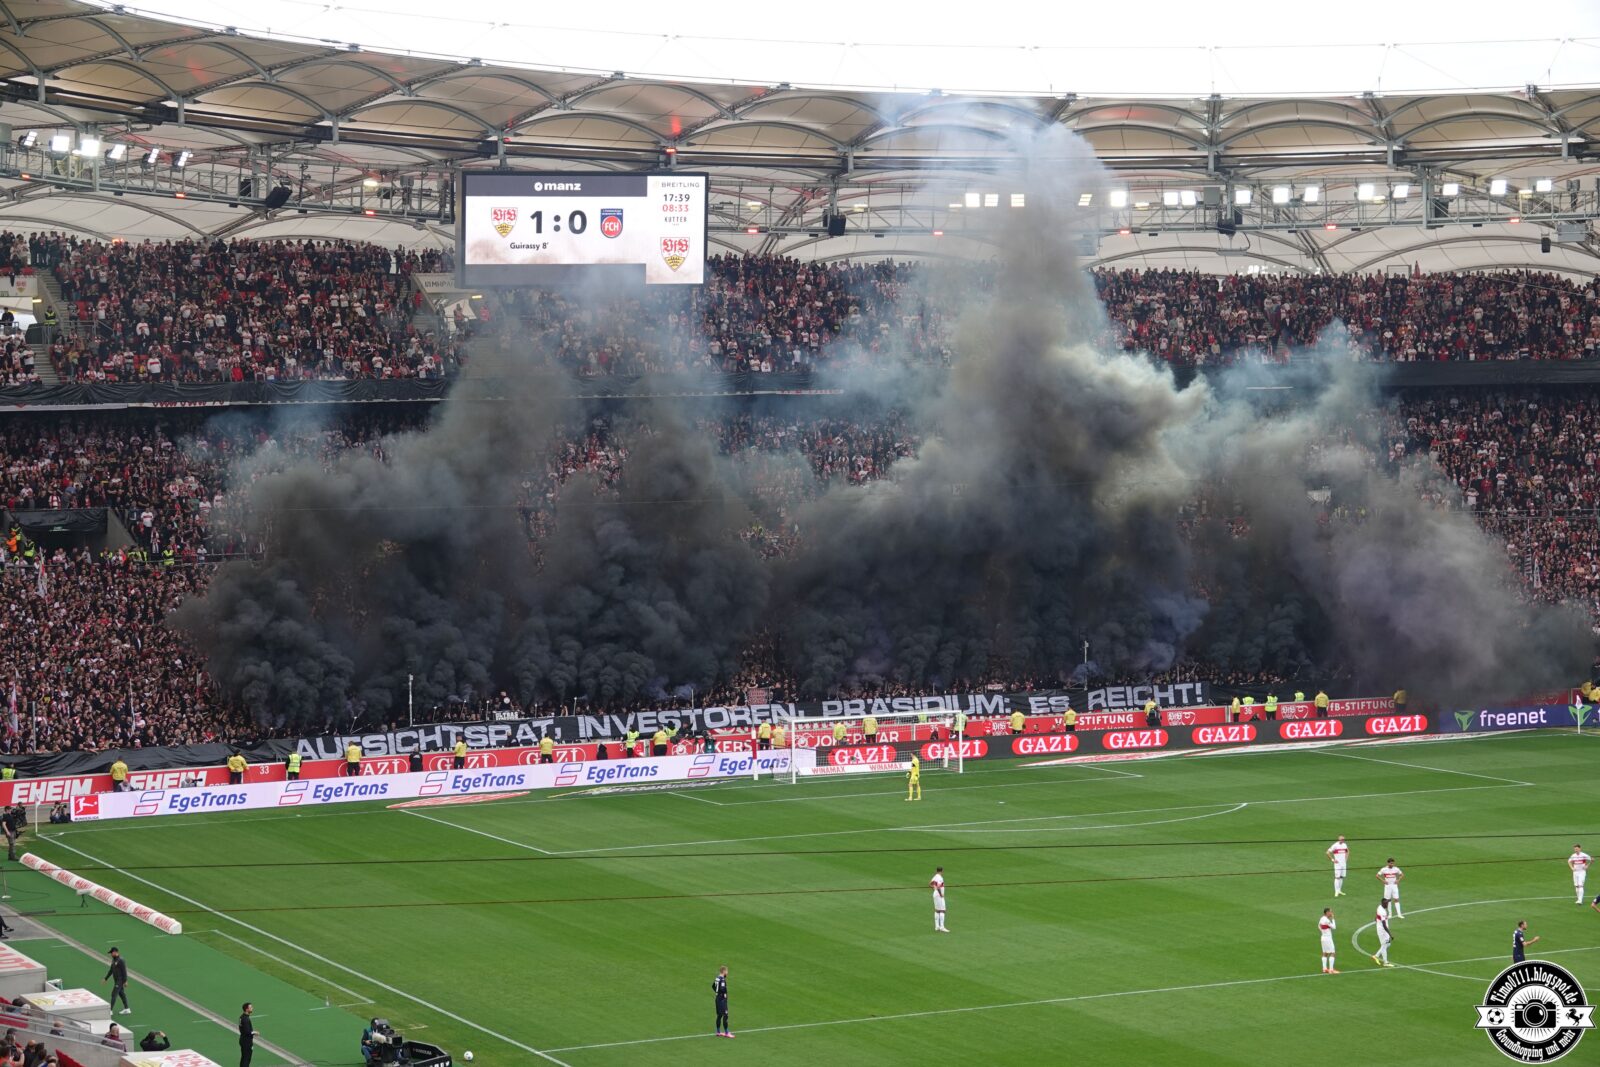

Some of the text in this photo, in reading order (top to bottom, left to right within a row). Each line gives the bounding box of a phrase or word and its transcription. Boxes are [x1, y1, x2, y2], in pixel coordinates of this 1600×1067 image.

[544, 183, 581, 191] manz
[664, 193, 690, 202] 17:39
[662, 204, 689, 212] 08:33
[510, 242, 540, 251] Guirassy
[1028, 696, 1070, 714] ES
[1087, 682, 1203, 711] REICHT!
[1244, 707, 1252, 715] 36
[1327, 701, 1395, 712] fB-STIFTUNG
[1480, 708, 1547, 727] freenet
[259, 766, 269, 775] 33
[811, 766, 846, 775] WINAMAX
[869, 762, 904, 771] WINAMAX
[587, 764, 658, 783] EgeTrans
[452, 773, 525, 792] EgeTrans
[12, 778, 93, 804] EHEIM
[313, 783, 388, 801] EgeTrans
[169, 792, 247, 812] EgeTrans
